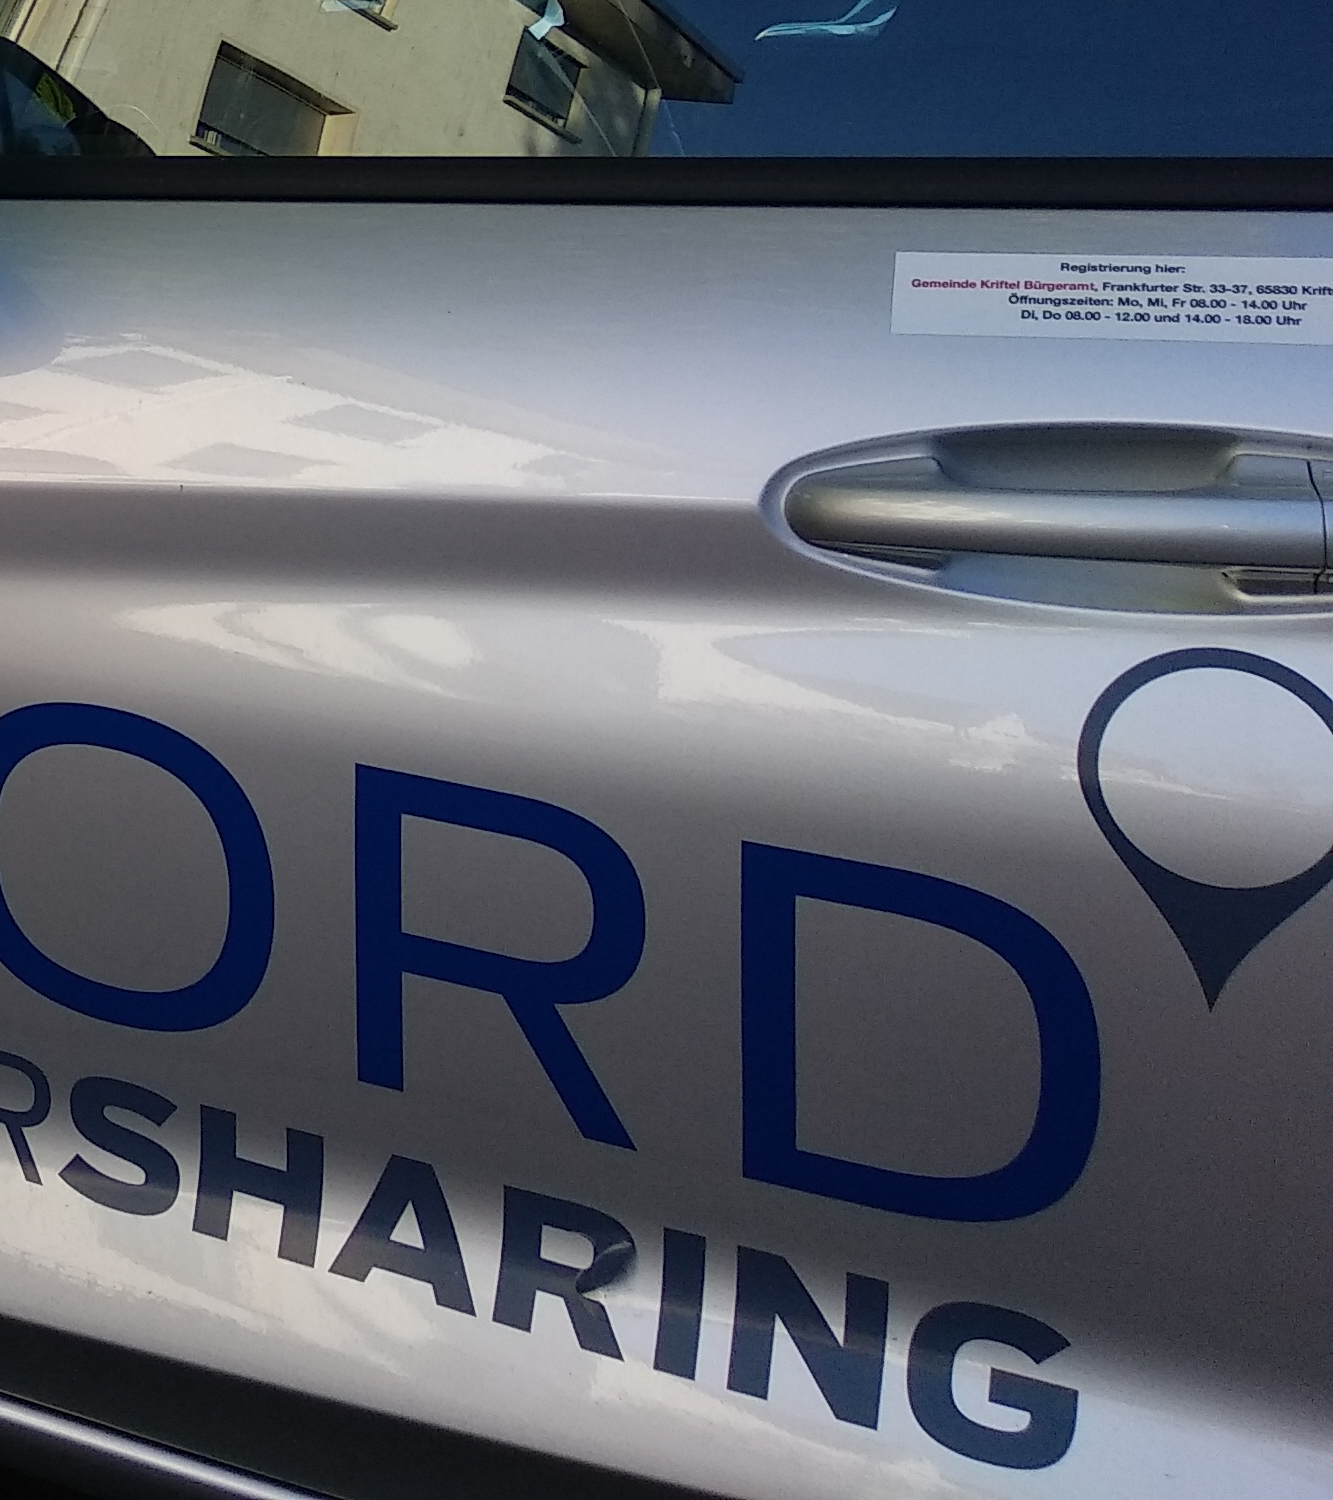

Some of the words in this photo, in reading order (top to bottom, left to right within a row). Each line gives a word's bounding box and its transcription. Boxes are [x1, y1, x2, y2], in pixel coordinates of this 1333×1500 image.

[1060, 262, 1151, 275] Registrierung
[1155, 263, 1186, 274] hier:
[911, 278, 977, 289] Gemeinde
[980, 280, 1020, 290] Kriftel
[1024, 280, 1099, 293] Bürgeramt,
[1102, 283, 1179, 293] Frankfurter
[1183, 283, 1206, 294] Str.
[1209, 284, 1252, 295] 33-37,
[1256, 285, 1298, 295] 65830
[1302, 285, 1333, 296] Krift
[1008, 293, 1113, 307] Öffnungszeiten:
[1118, 298, 1143, 308] Mo,
[1147, 298, 1168, 309] Mi,
[1172, 299, 1187, 308] Fr
[1190, 299, 1227, 309] 08.00
[1242, 300, 1278, 310] 14.00
[1282, 301, 1308, 311] Uhr
[1021, 309, 1039, 320] Di,
[1042, 310, 1061, 320] Do
[1065, 311, 1101, 321] 08.00
[1115, 312, 1151, 322] 12.00
[1154, 313, 1180, 323] und
[1185, 314, 1221, 324] 14.00
[1235, 315, 1272, 325] 18.00
[1276, 316, 1302, 326] Uhr
